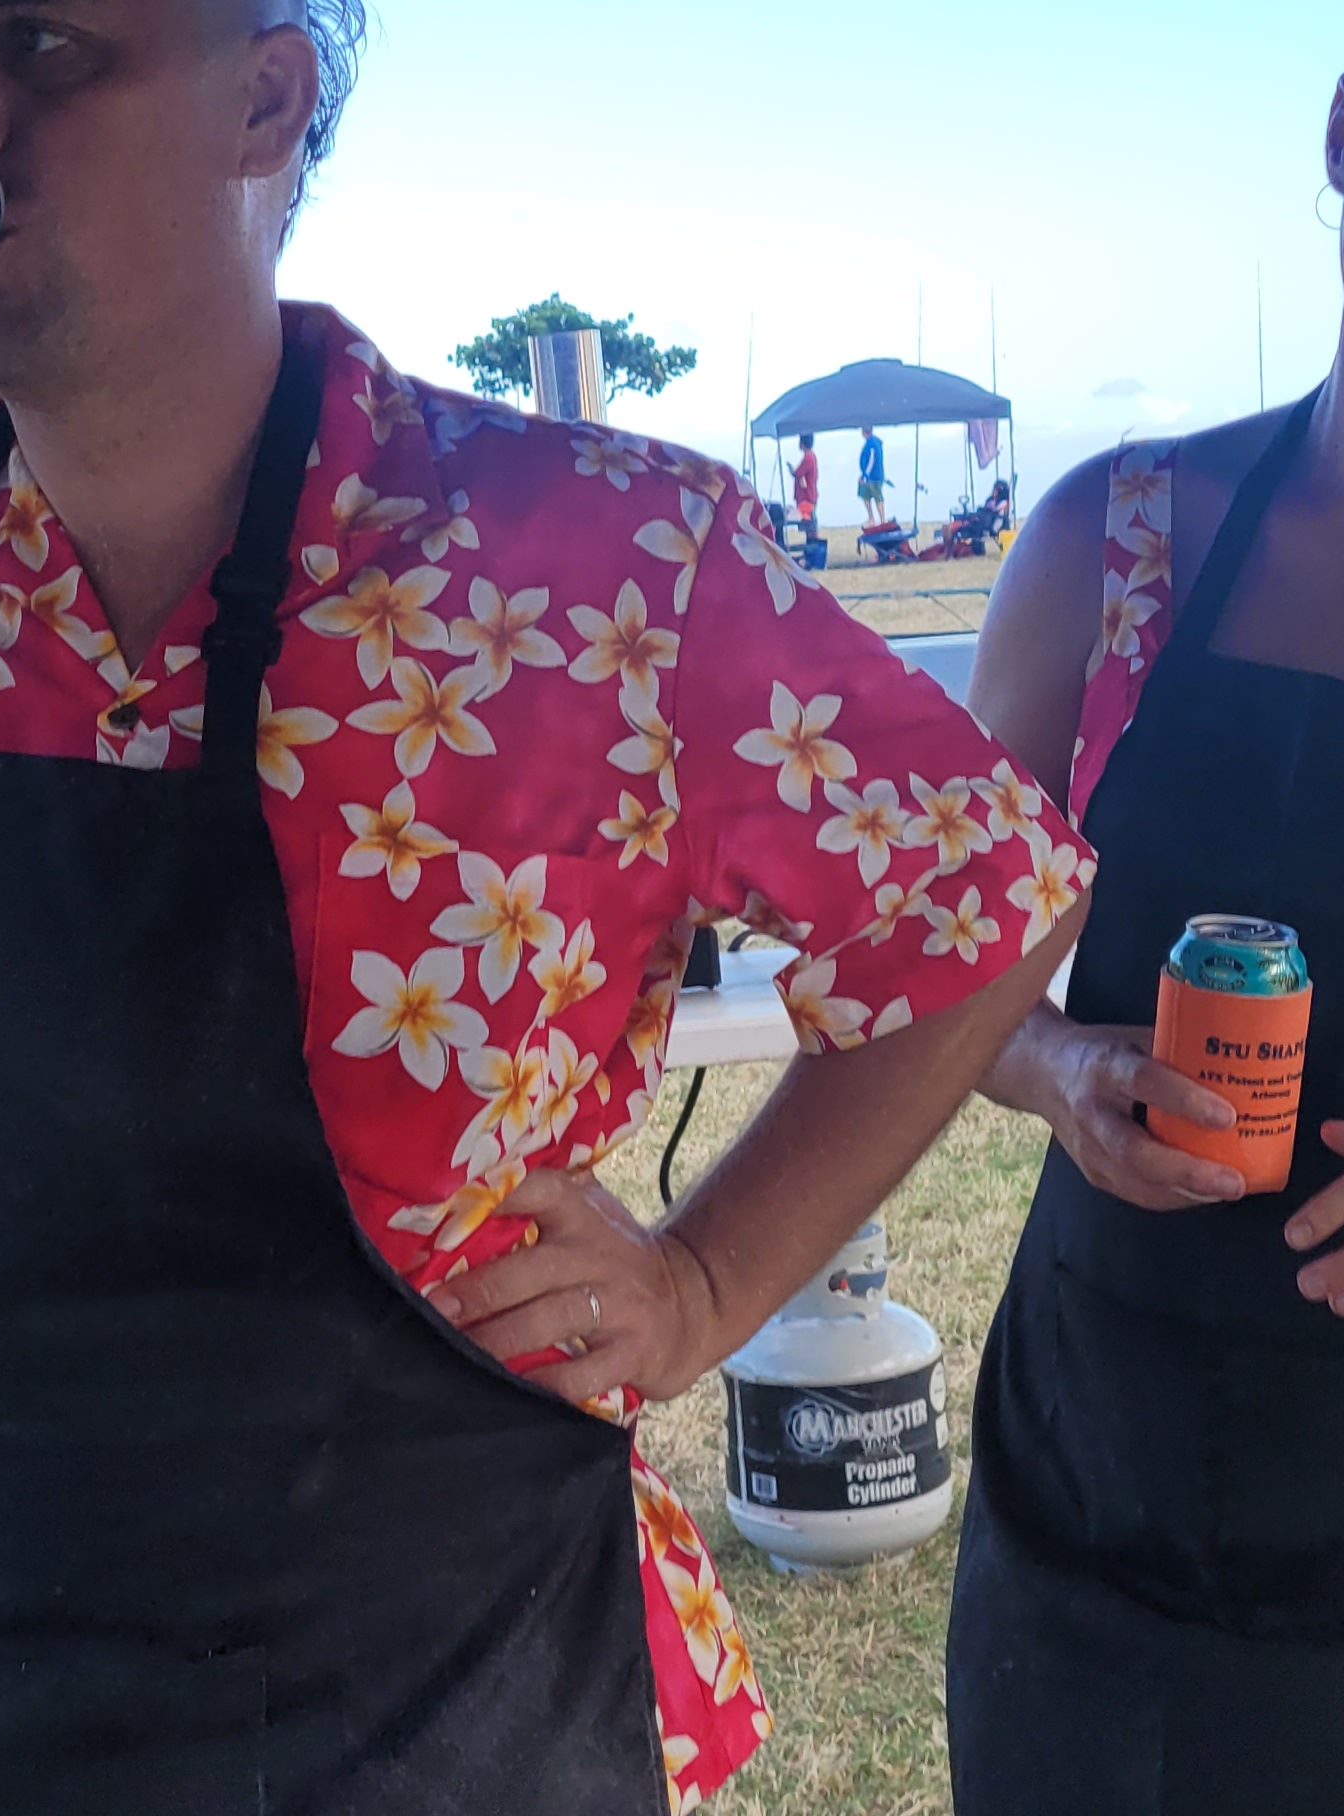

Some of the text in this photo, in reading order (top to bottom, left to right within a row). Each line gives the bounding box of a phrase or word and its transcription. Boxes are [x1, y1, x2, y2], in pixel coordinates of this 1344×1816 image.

[1267, 1074, 1285, 1086] and
[798, 1398, 928, 1443] MANCHESTER
[845, 1453, 916, 1482] Propane
[847, 1474, 917, 1506] Cylinder
